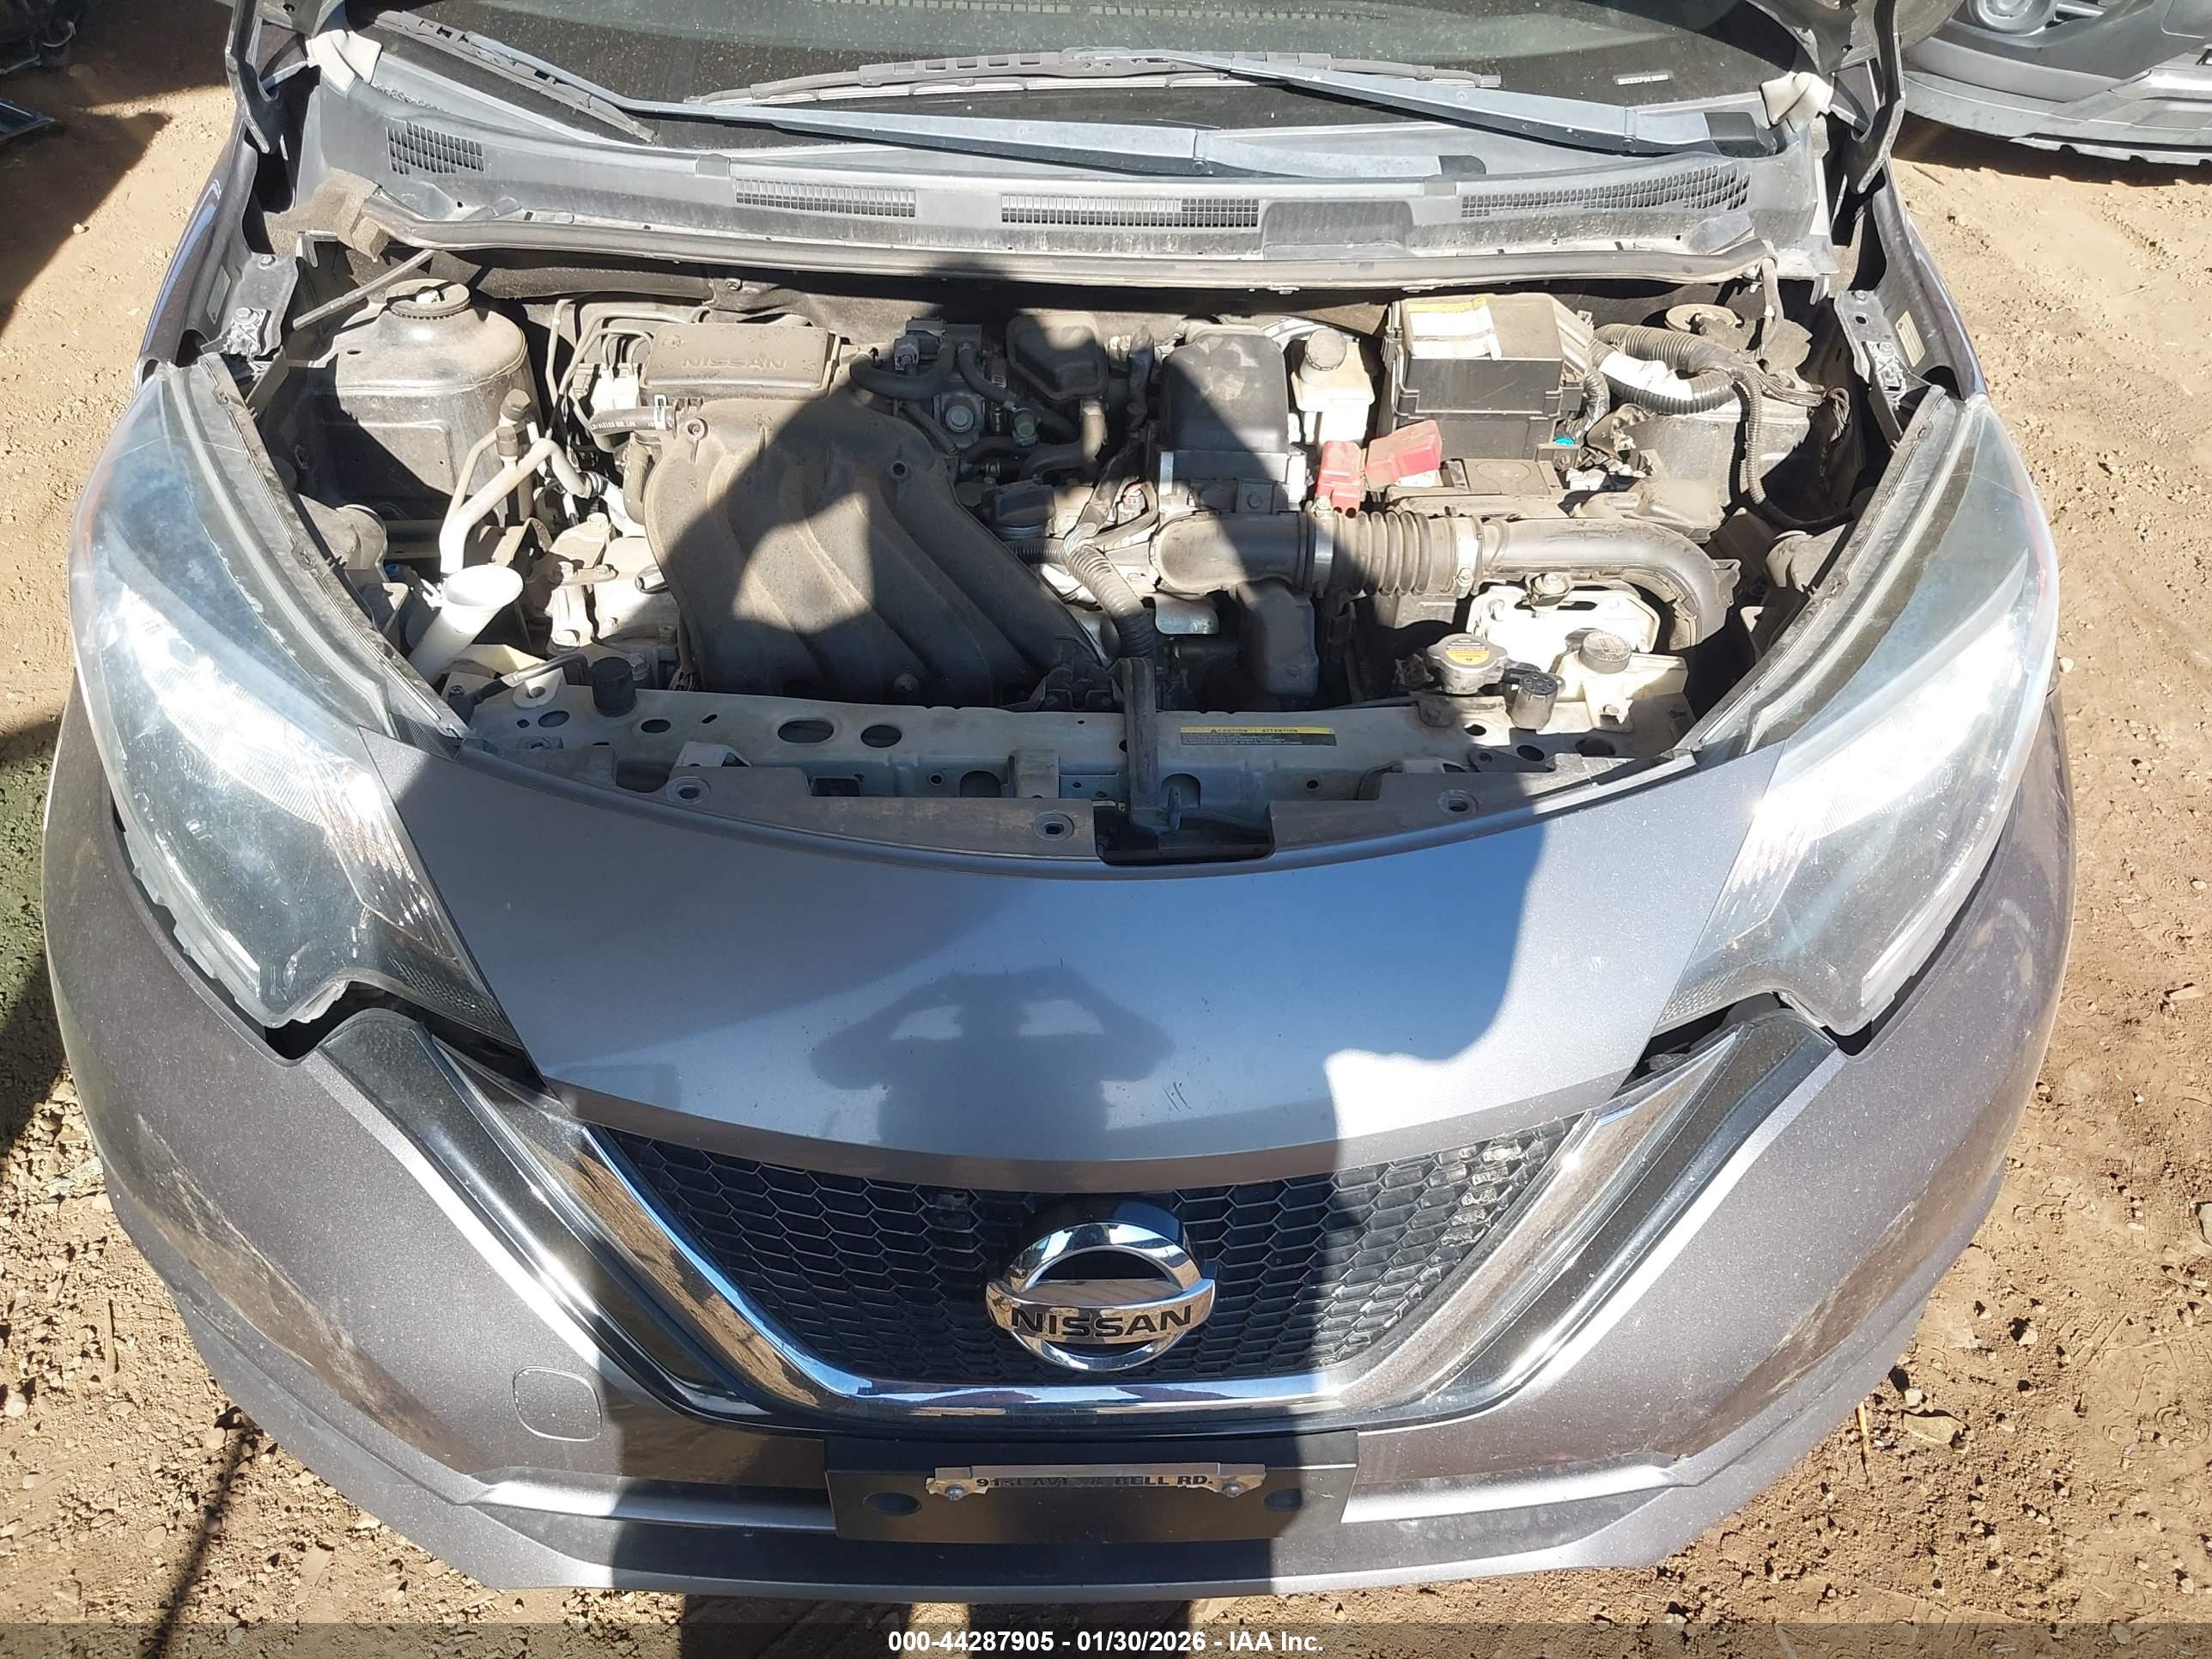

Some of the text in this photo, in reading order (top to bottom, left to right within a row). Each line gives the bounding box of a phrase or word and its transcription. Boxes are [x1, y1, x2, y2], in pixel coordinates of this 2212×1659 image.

[682, 356, 787, 370] NISSAN
[1012, 1304, 1192, 1338] NISSAN
[1176, 1475, 1213, 1486] RD.
